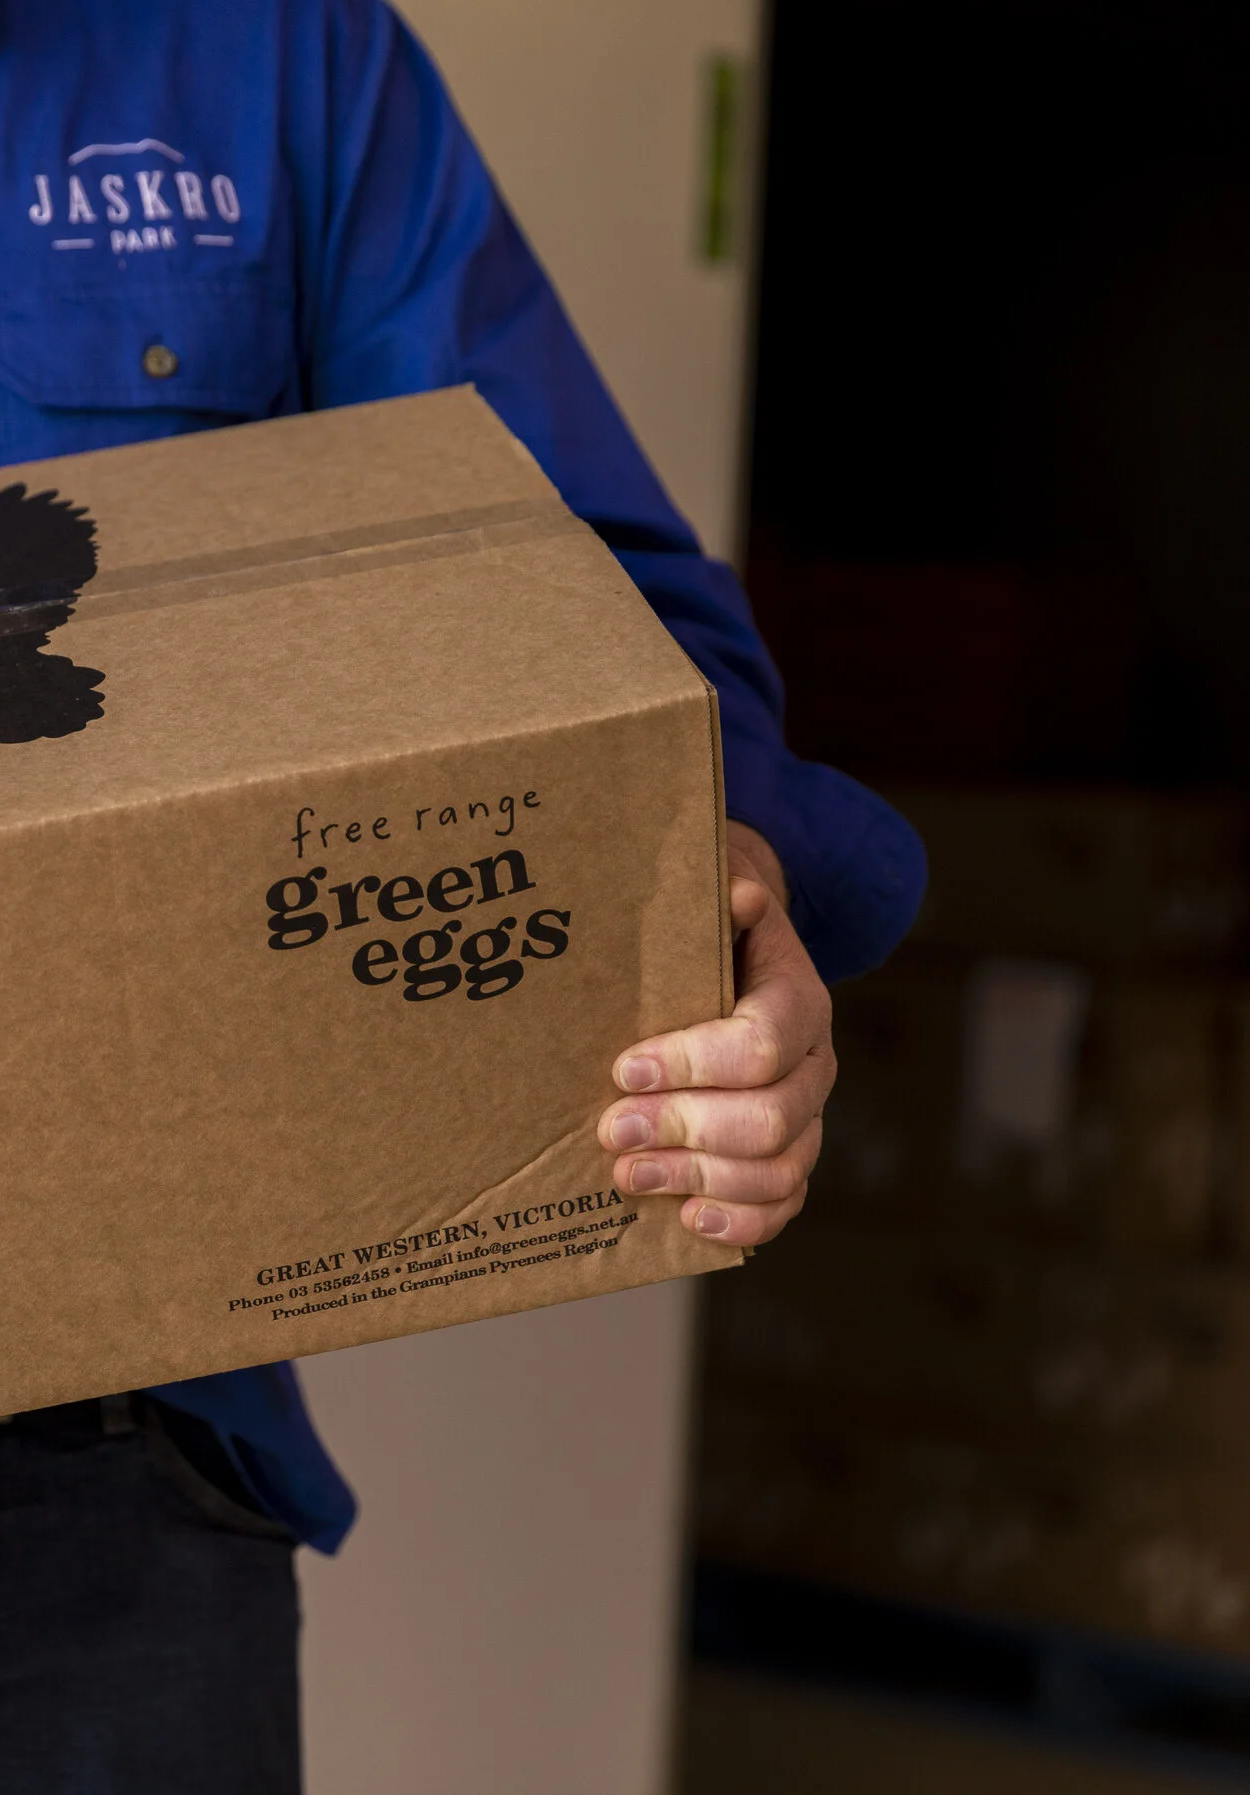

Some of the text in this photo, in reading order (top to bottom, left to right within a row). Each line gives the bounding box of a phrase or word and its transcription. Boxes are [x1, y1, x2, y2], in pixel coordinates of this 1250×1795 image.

[29, 170, 241, 226] JASKRO
[110, 225, 177, 255] PARK
[291, 790, 541, 858] free range
[265, 849, 537, 950] green
[352, 908, 571, 1001] eggs
[228, 1212, 639, 1312] Phone 03 53562458 Email info@greeneggs.net.au
[256, 1188, 623, 1286] GREAT WESTERN, VICTORIA
[271, 1236, 618, 1321] Produced in the Grampians Pyrenees Region
